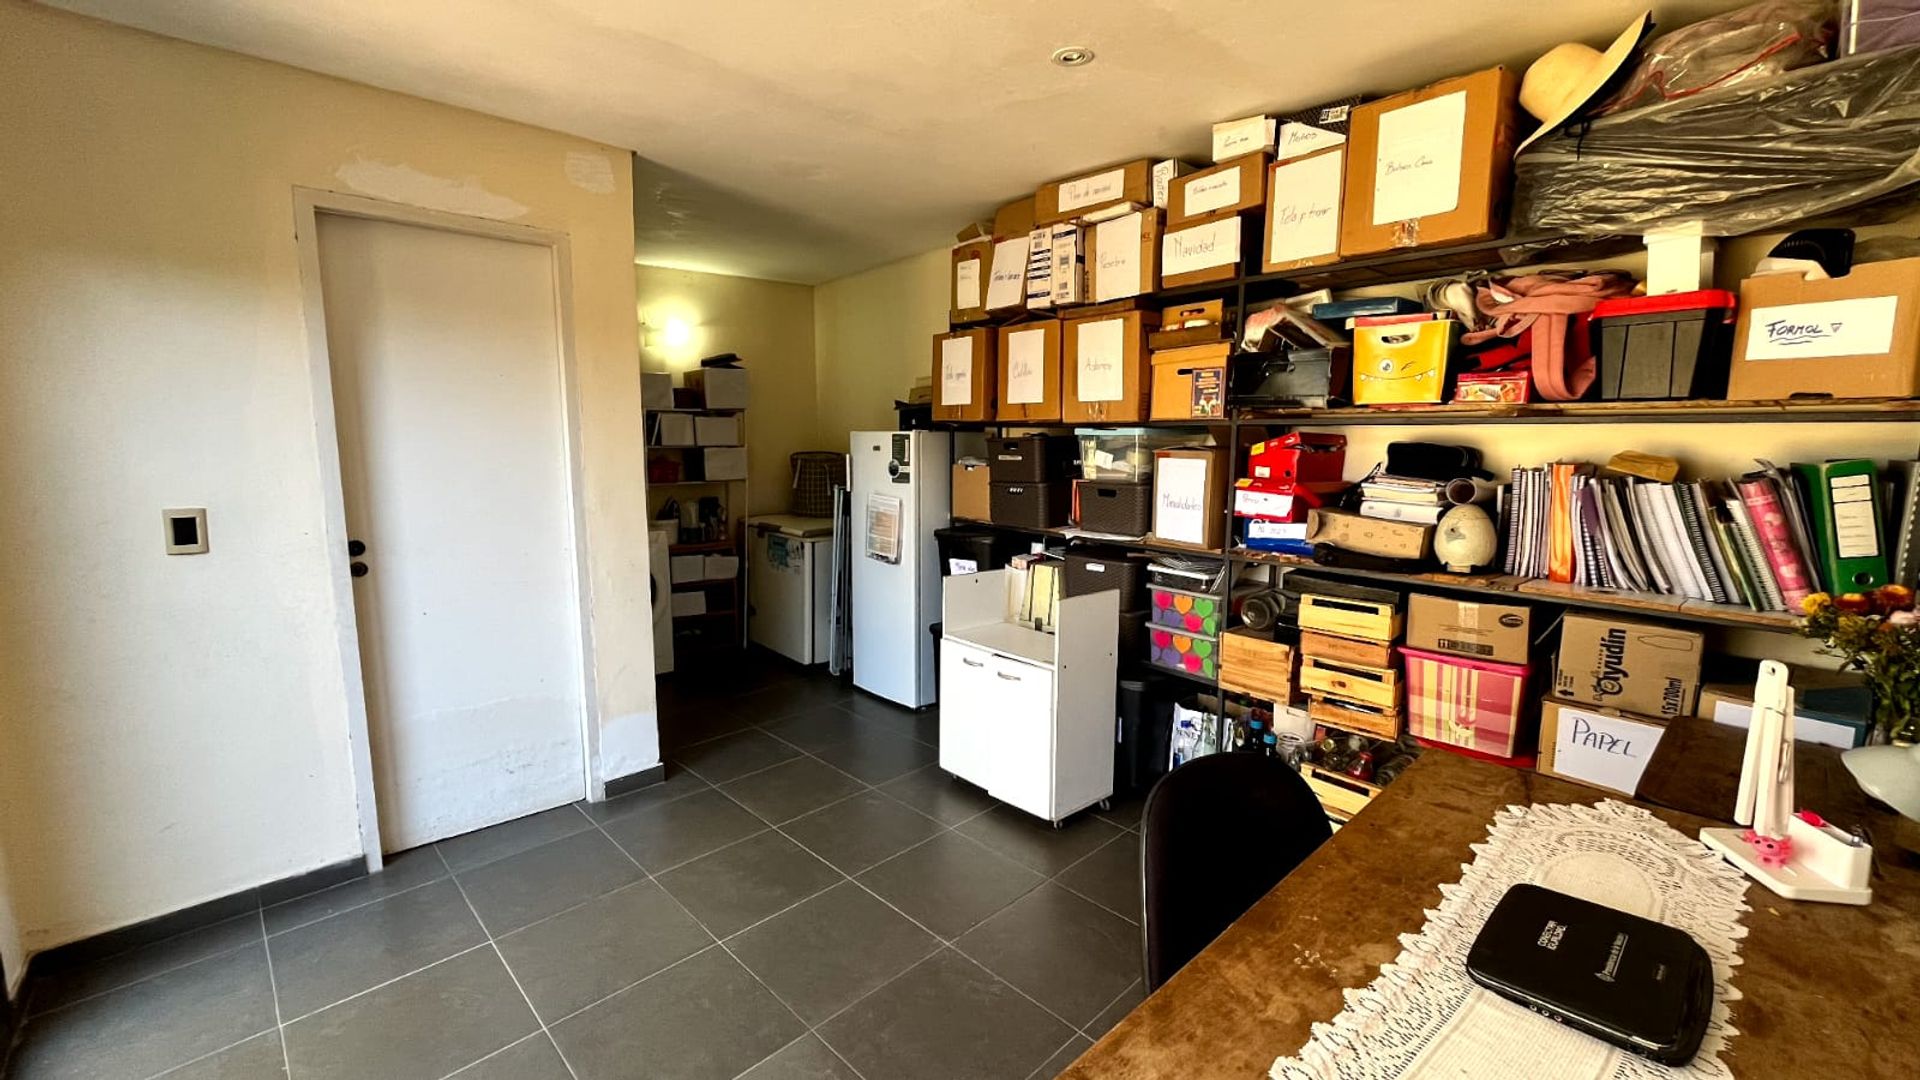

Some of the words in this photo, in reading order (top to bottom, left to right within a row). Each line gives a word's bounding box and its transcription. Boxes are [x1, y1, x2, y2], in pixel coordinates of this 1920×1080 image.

[1174, 231, 1216, 258] Navidad
[1765, 320, 1823, 338] FORMOL
[1572, 716, 1637, 758] PAPEL
